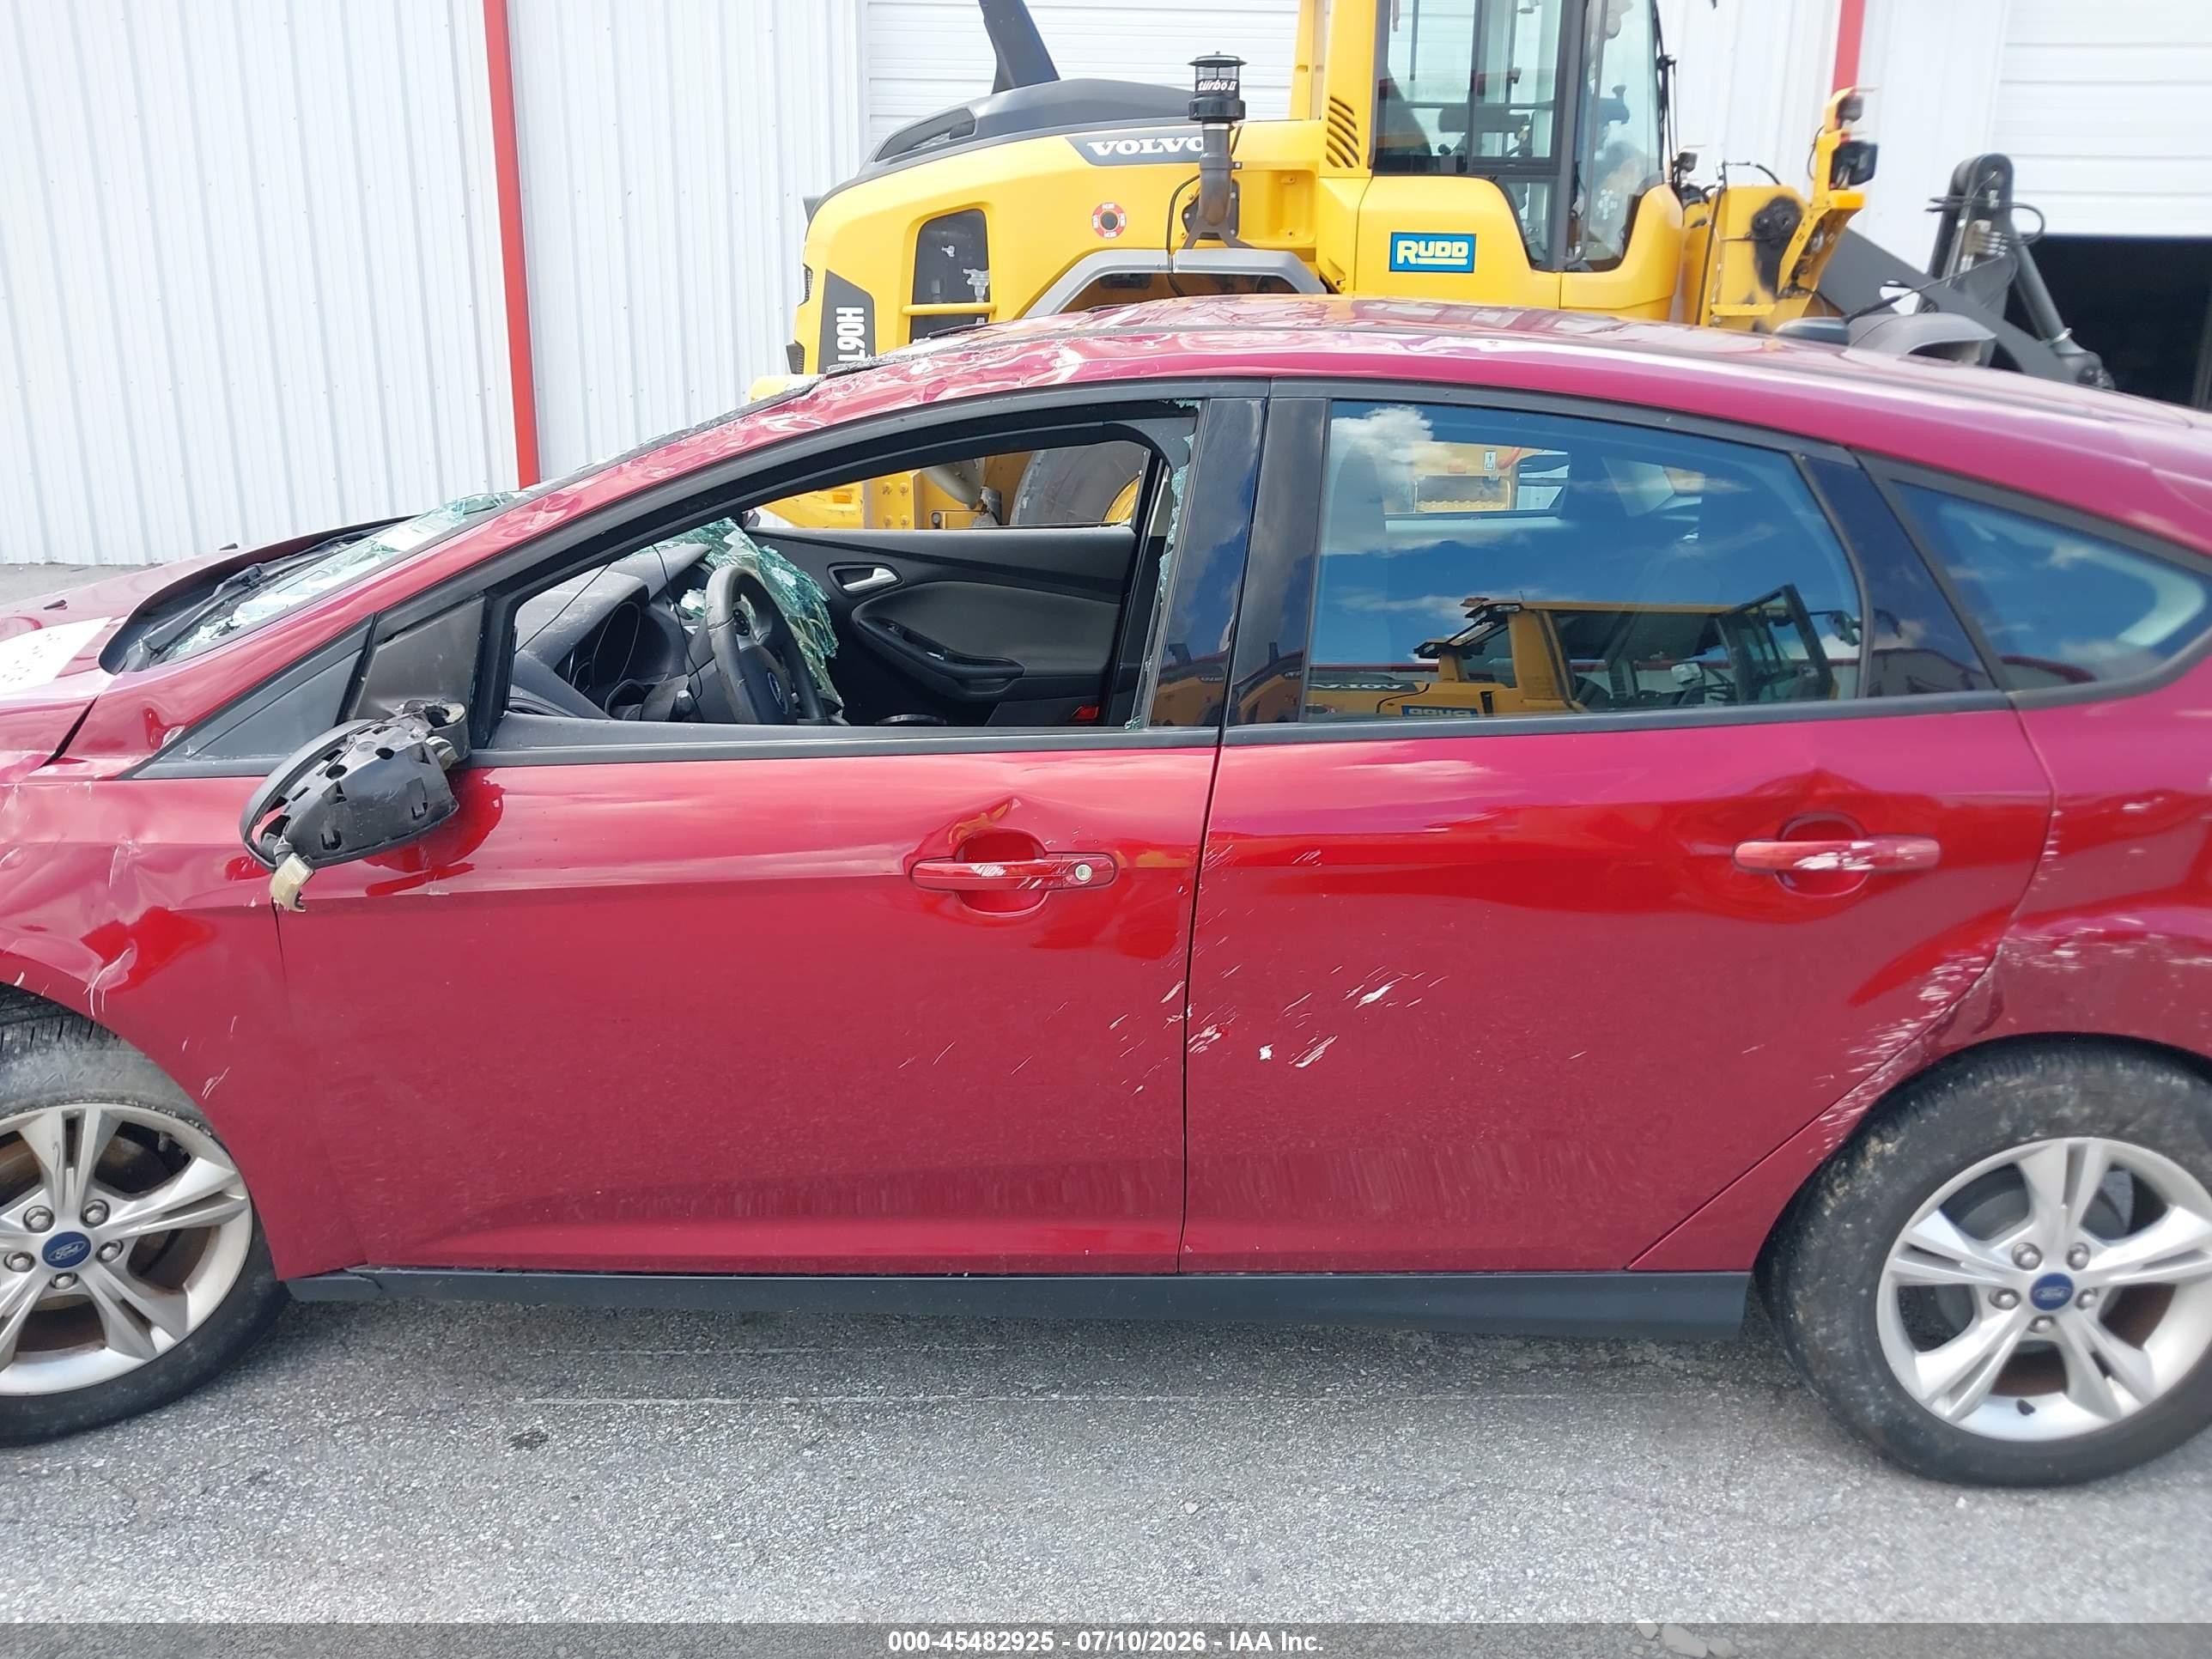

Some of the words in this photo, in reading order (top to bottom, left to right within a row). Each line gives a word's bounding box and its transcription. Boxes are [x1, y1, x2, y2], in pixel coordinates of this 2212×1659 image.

[1197, 79, 1228, 91] turbo
[1227, 81, 1238, 91] II
[1087, 136, 1203, 156] VOLVO
[1396, 240, 1469, 265] RUDD
[836, 307, 866, 362] L90H
